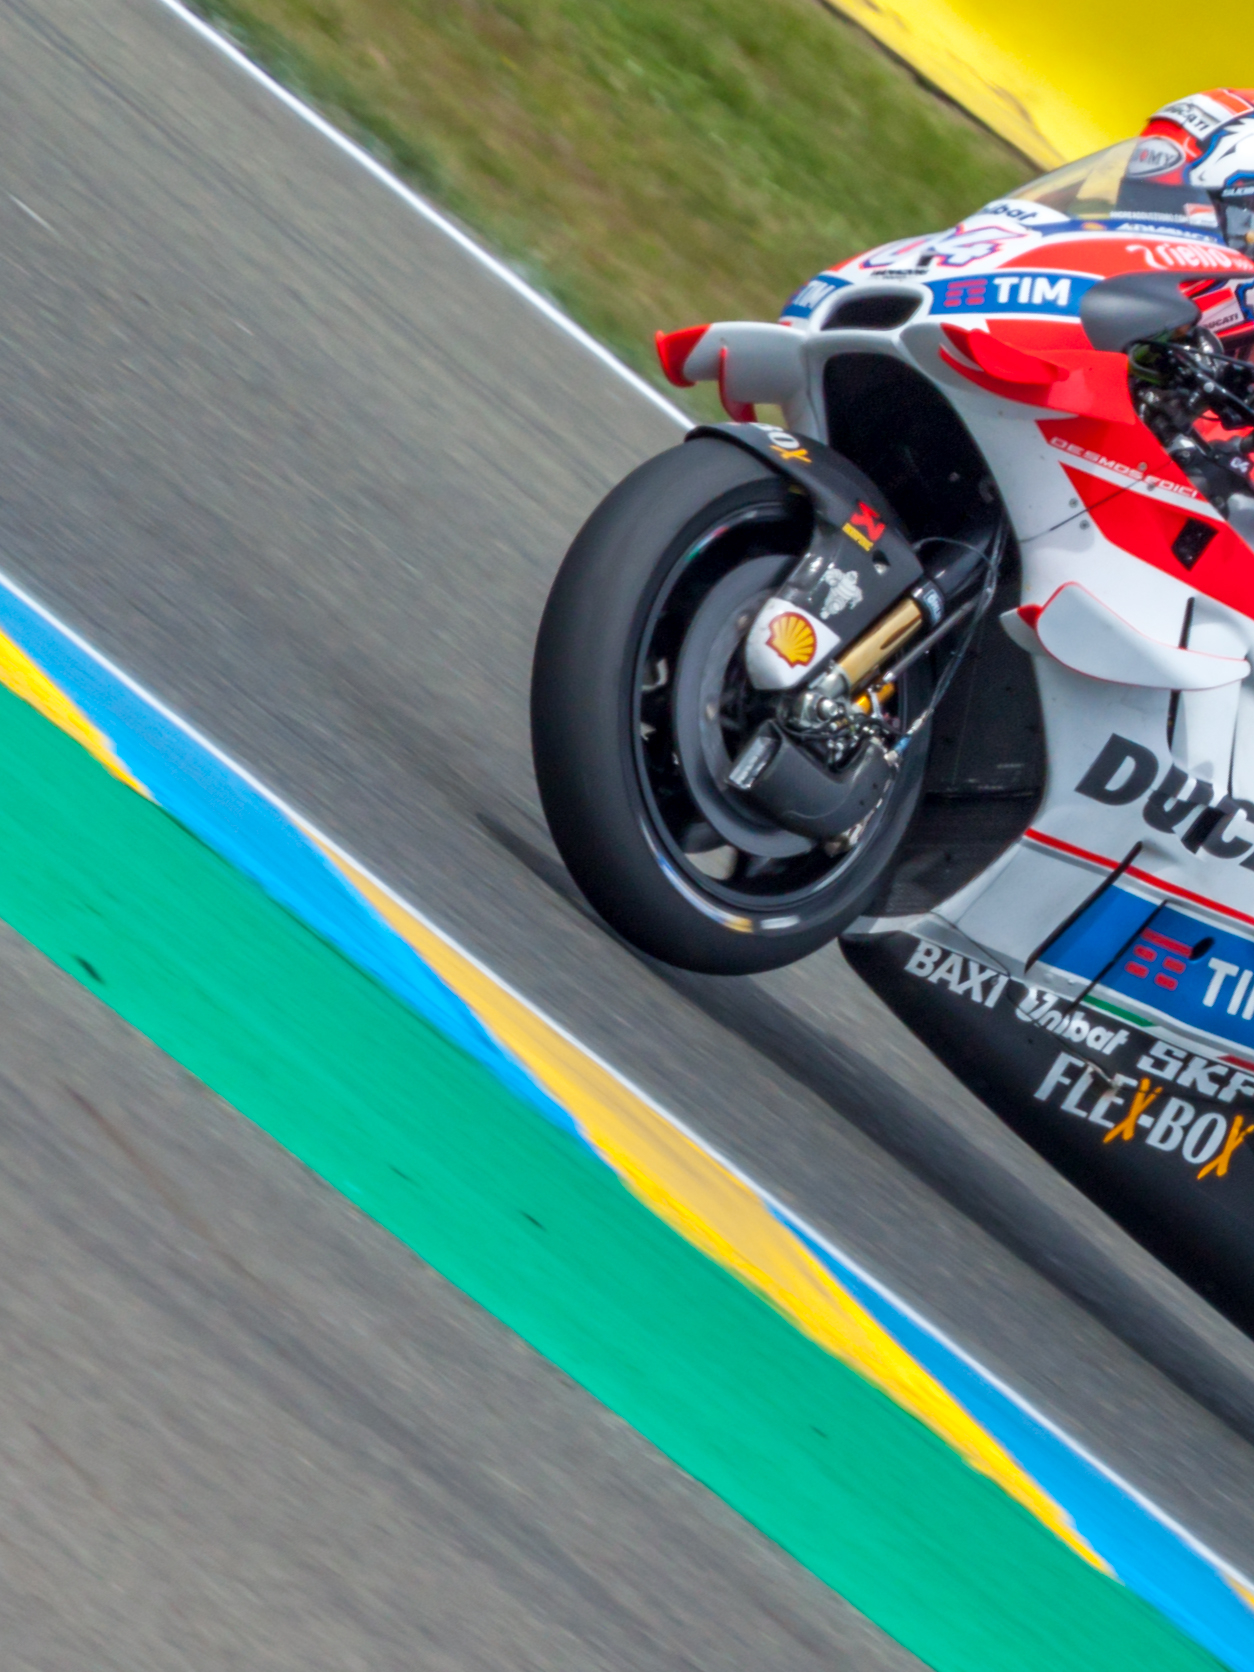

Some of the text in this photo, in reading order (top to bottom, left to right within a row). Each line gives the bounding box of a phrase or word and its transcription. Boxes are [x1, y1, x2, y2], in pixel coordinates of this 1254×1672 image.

[1156, 242, 1232, 267] riello
[992, 276, 1072, 307] TIM
[904, 940, 1012, 1009] BAXI
